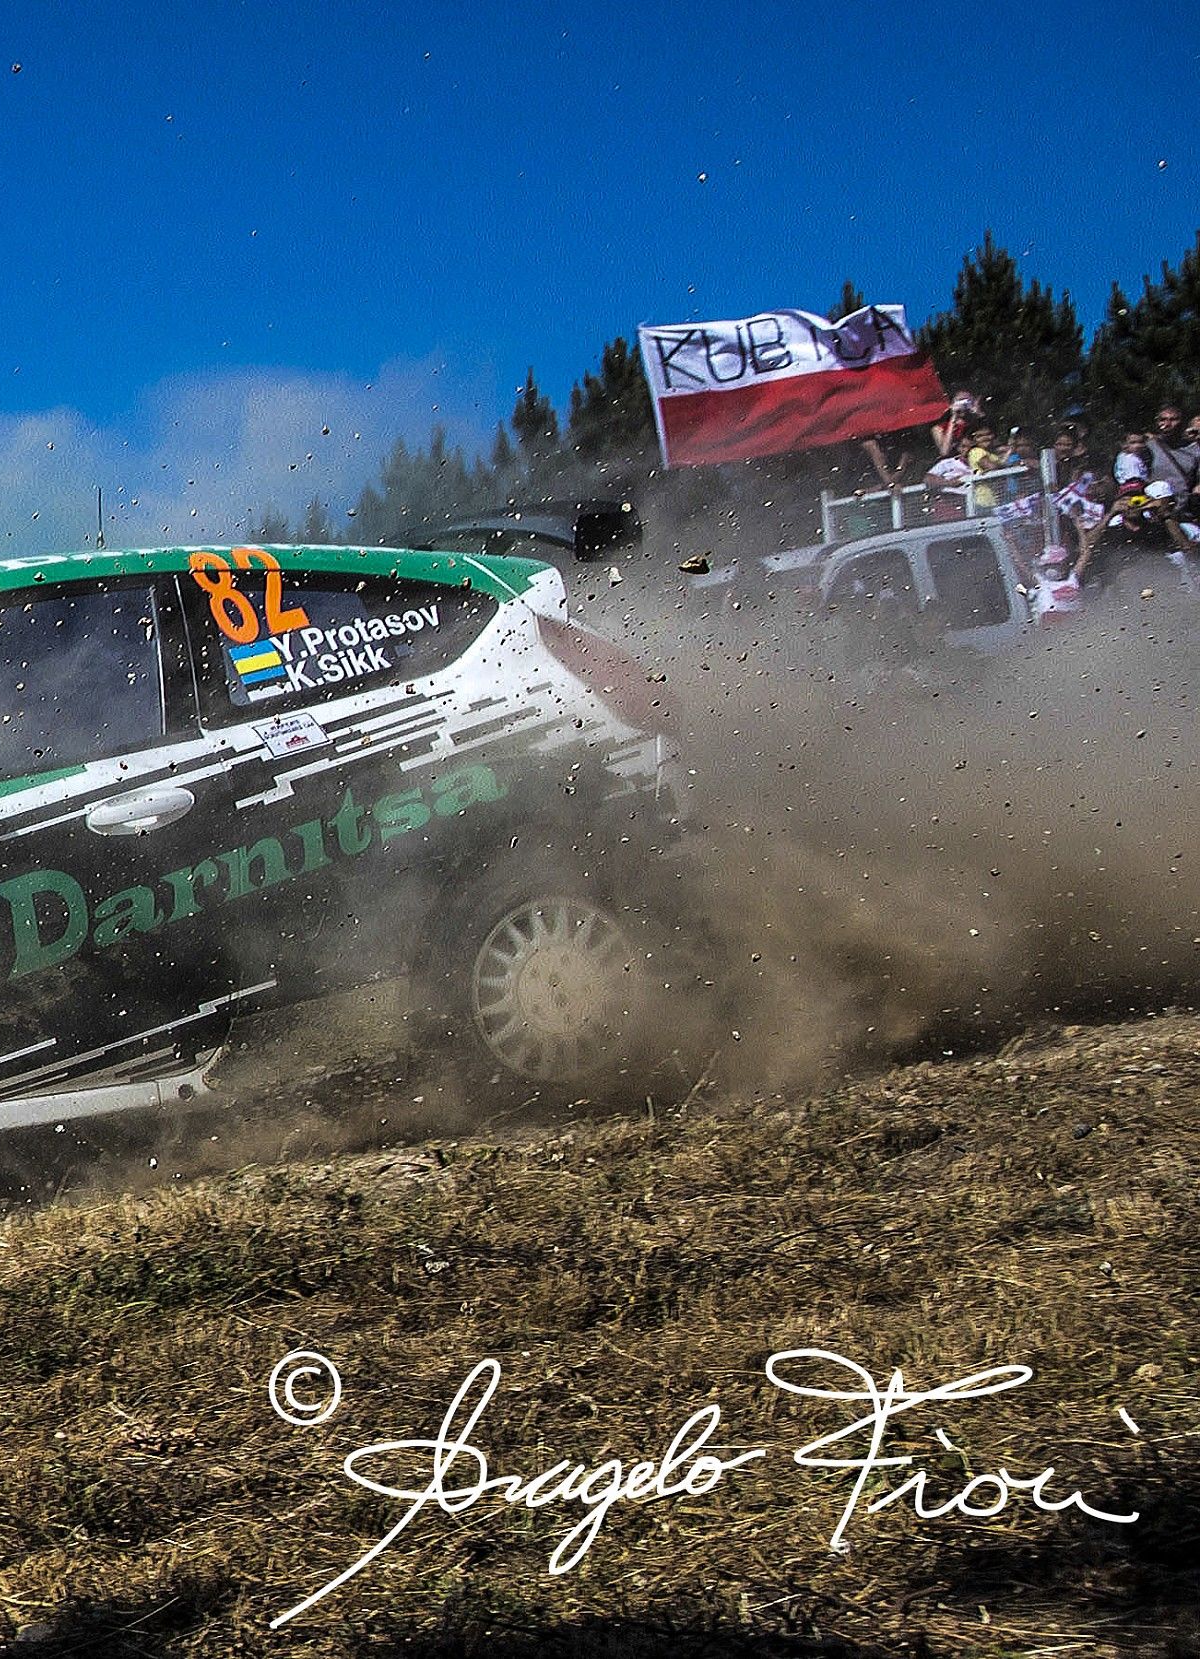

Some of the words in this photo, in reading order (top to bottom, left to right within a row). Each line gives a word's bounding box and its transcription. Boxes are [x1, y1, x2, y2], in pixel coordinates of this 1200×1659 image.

[188, 547, 311, 645] 82
[271, 602, 442, 663] Y.Protasov
[286, 643, 392, 693] K.Sikk
